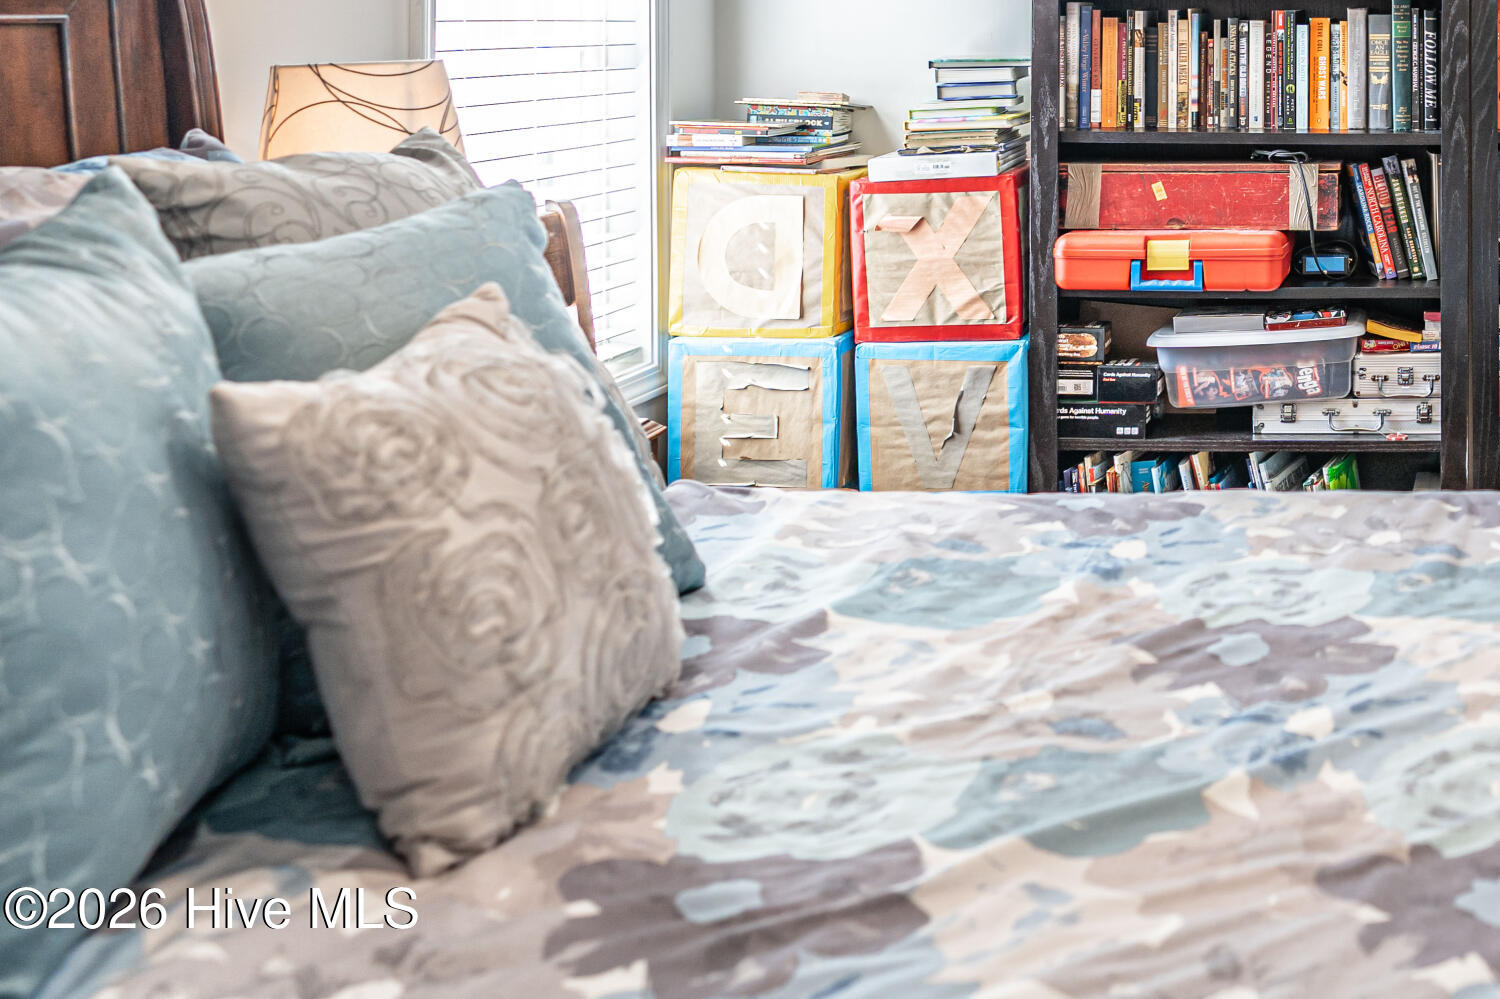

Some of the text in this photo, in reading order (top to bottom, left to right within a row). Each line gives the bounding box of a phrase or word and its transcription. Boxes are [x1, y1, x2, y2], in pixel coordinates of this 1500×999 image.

[1179, 42, 1187, 85] KILLER ANGELS
[1425, 31, 1436, 108] FOLLOW ME
[1357, 185, 1373, 232] CAROLINA ROCKS
[1366, 187, 1388, 253] NORTH CAROLINA
[1374, 175, 1398, 233] BLOOD YEAR
[698, 194, 804, 320] D
[875, 191, 998, 322] X
[1297, 367, 1320, 395] enga
[880, 365, 997, 488] V
